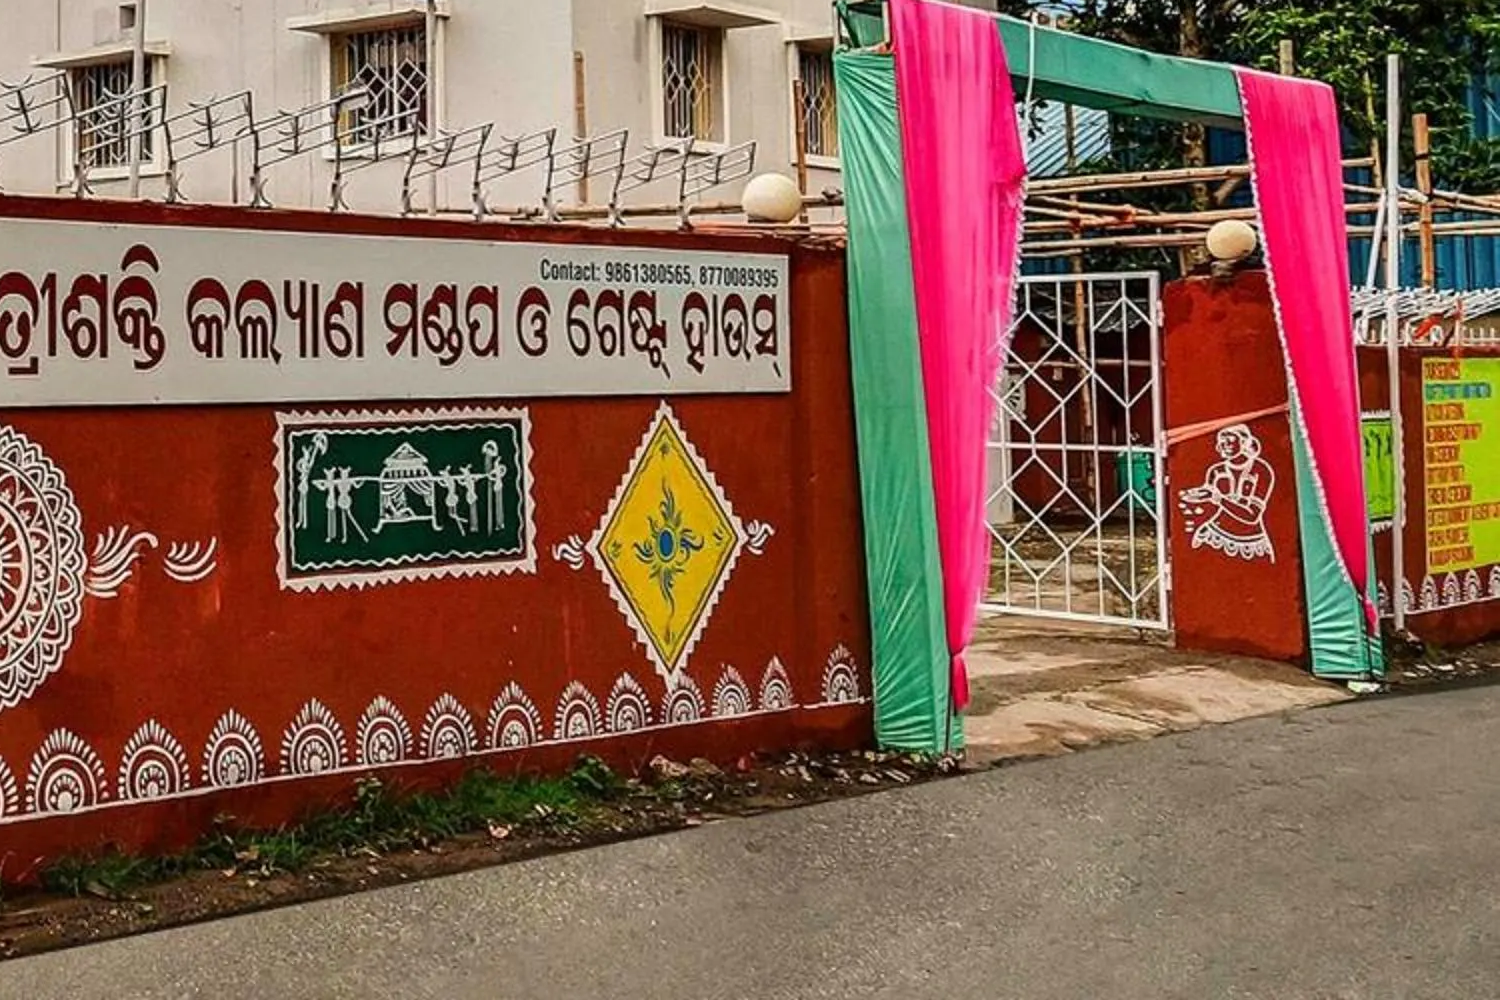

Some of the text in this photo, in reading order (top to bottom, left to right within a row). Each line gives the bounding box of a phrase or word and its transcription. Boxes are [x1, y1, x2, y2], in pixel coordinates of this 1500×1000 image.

[540, 259, 778, 287] Contact: 9861380565, 8770089395
[384, 283, 499, 365] ମଣ୍ଡପ
[516, 286, 550, 357] ଓ
